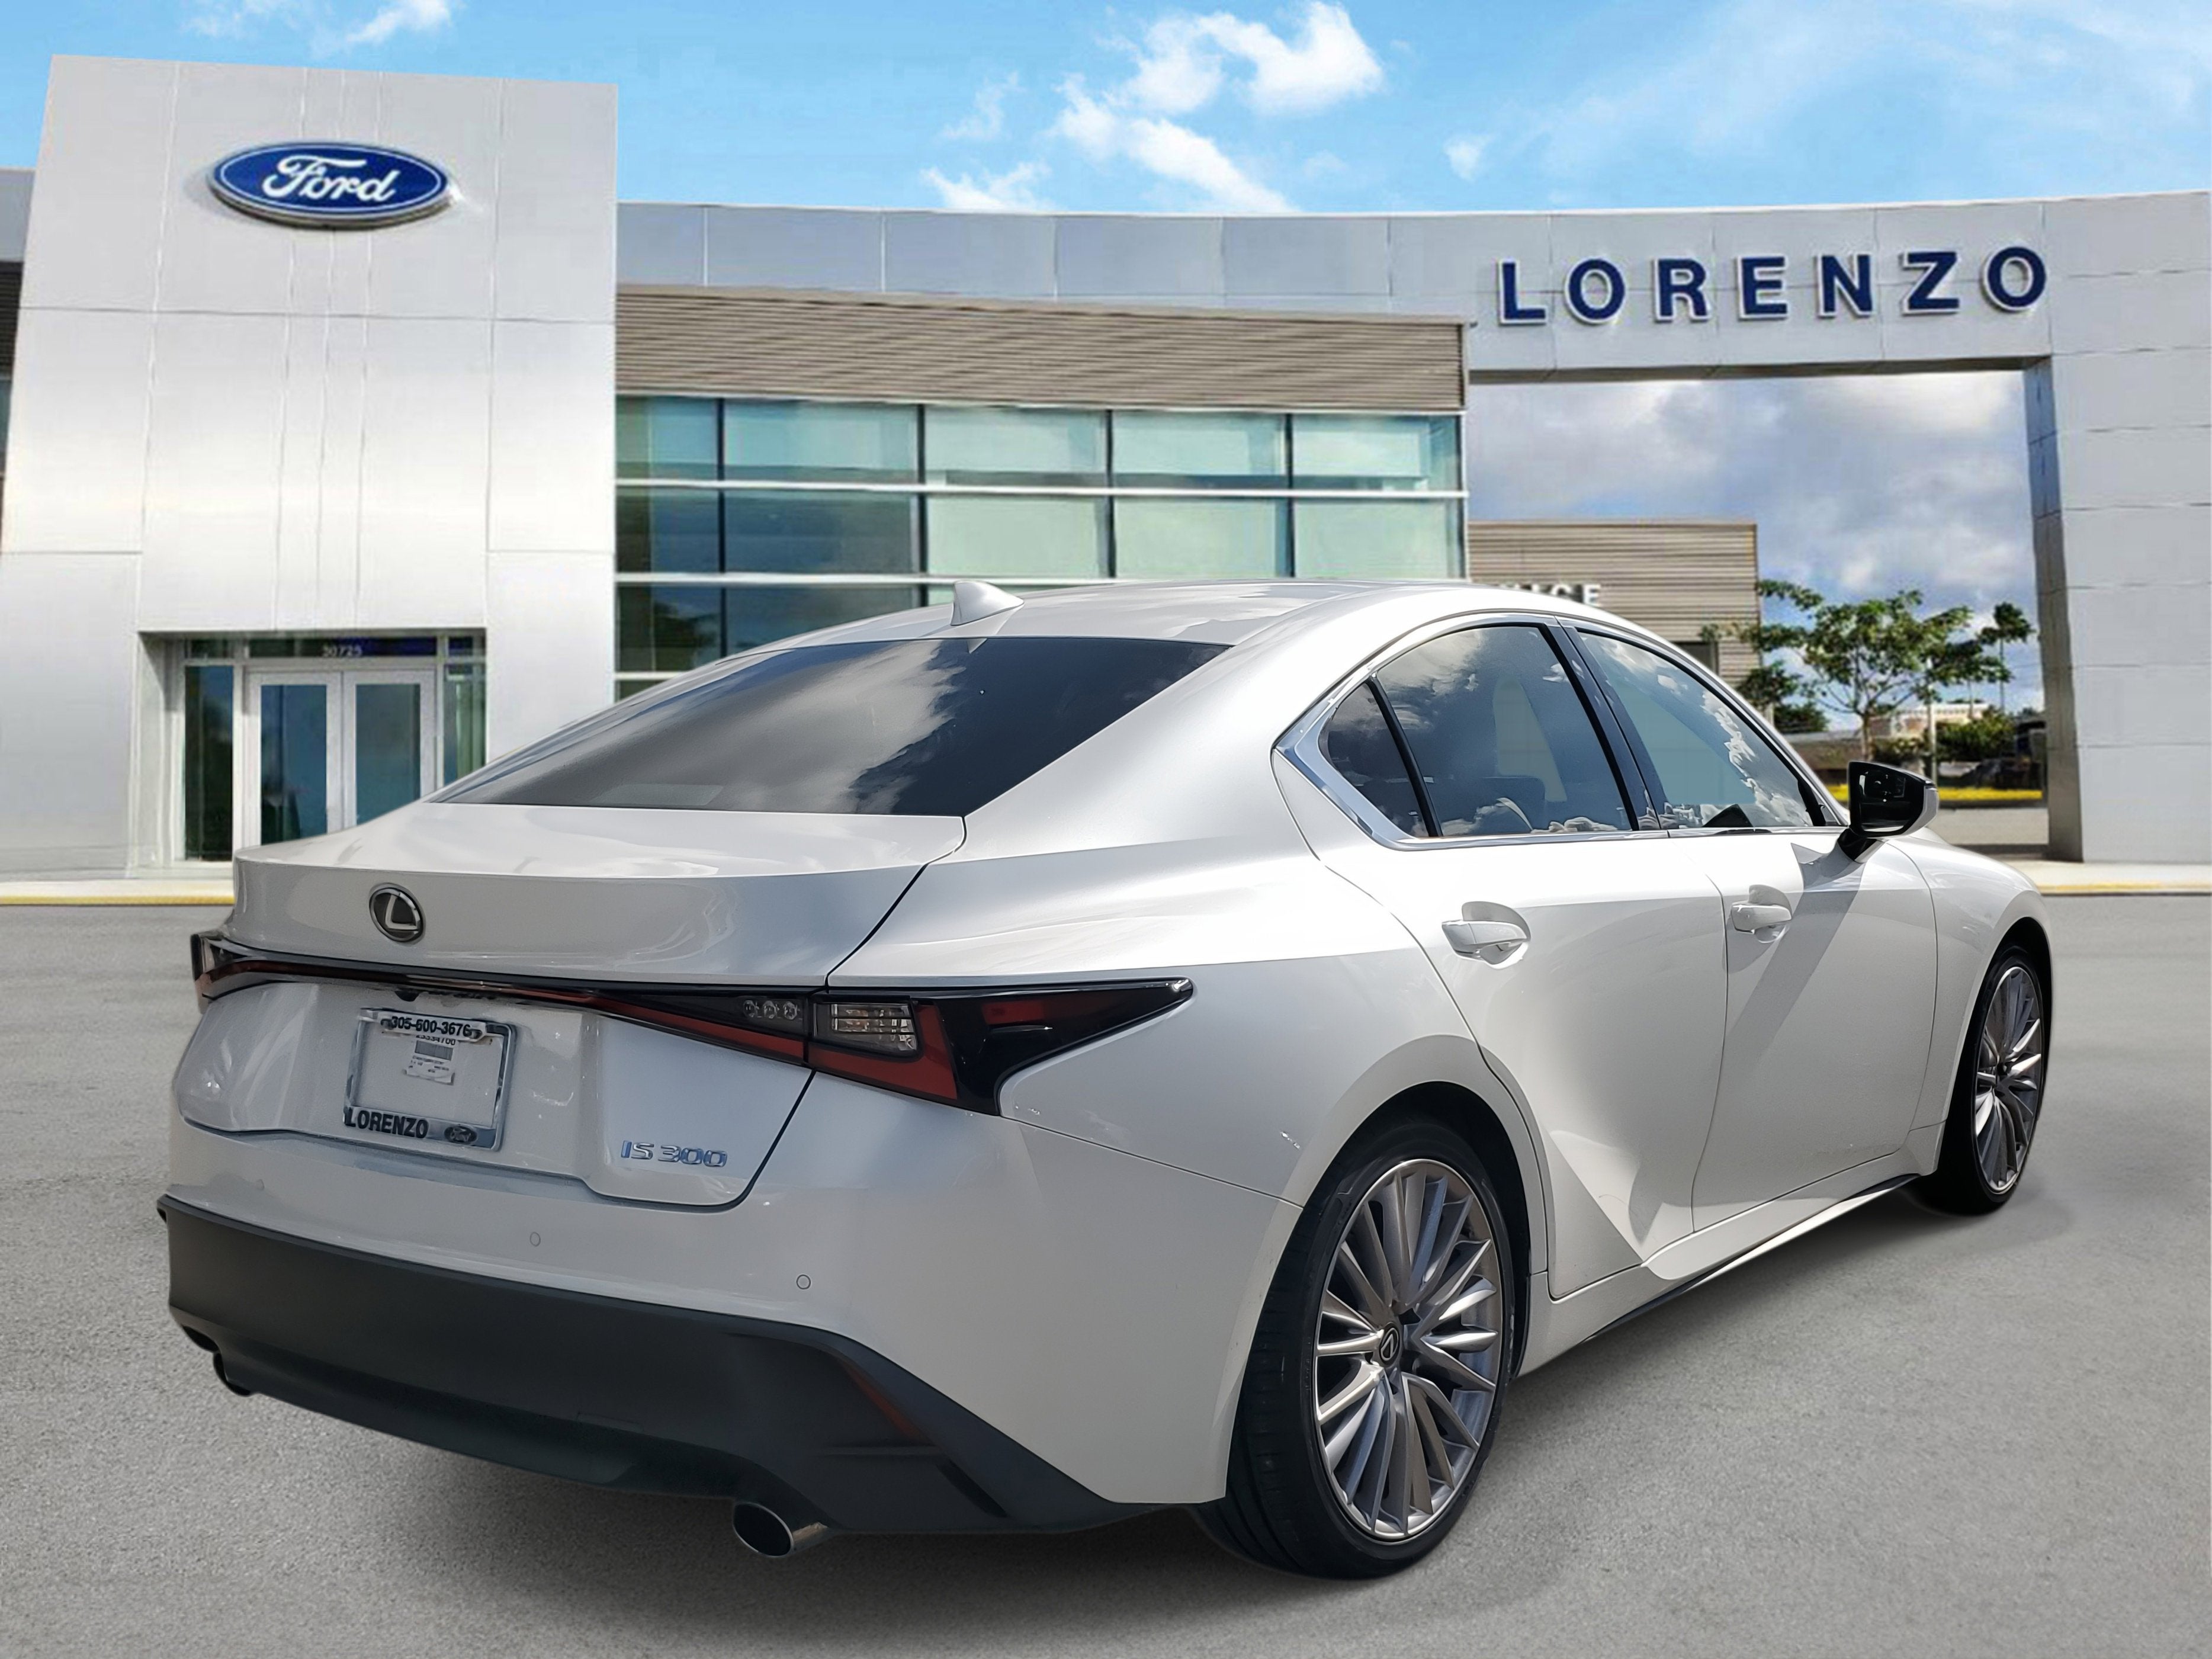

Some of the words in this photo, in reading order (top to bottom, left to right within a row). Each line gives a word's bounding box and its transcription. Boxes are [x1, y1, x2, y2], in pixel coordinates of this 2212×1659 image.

[262, 154, 400, 201] Ford
[1498, 246, 2047, 325] LORENZO
[391, 1016, 473, 1037] 305-600-3676
[344, 1106, 429, 1138] LORENZO
[620, 1140, 654, 1160] IS
[658, 1145, 728, 1167] 300
